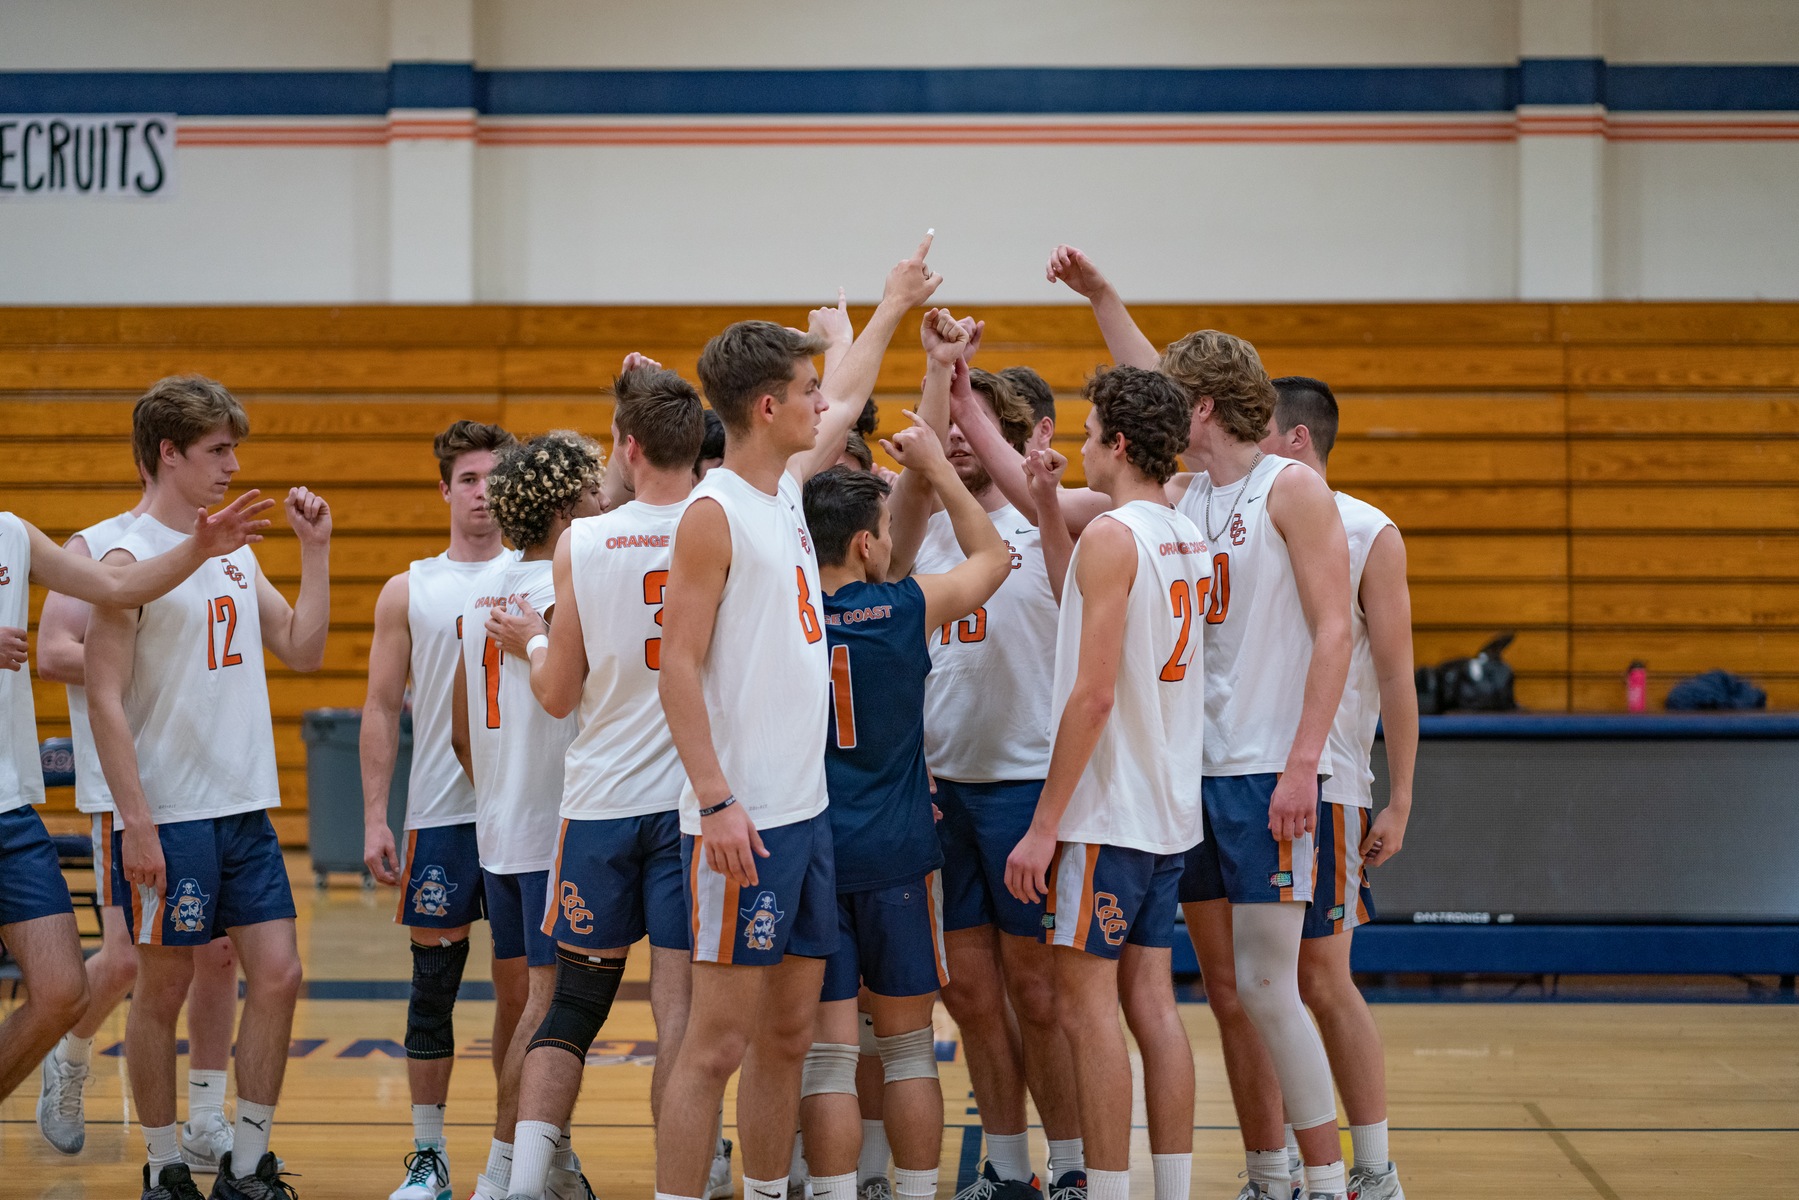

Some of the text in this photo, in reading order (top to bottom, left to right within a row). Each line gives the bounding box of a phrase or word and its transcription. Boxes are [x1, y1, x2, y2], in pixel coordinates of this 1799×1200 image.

[0, 120, 166, 194] ECRUITS
[605, 534, 670, 549] ORANGE
[207, 595, 243, 670] 12
[842, 604, 893, 625] COAST
[829, 644, 857, 749] 1
[561, 880, 594, 935] OCC
[1095, 891, 1128, 946] OCC
